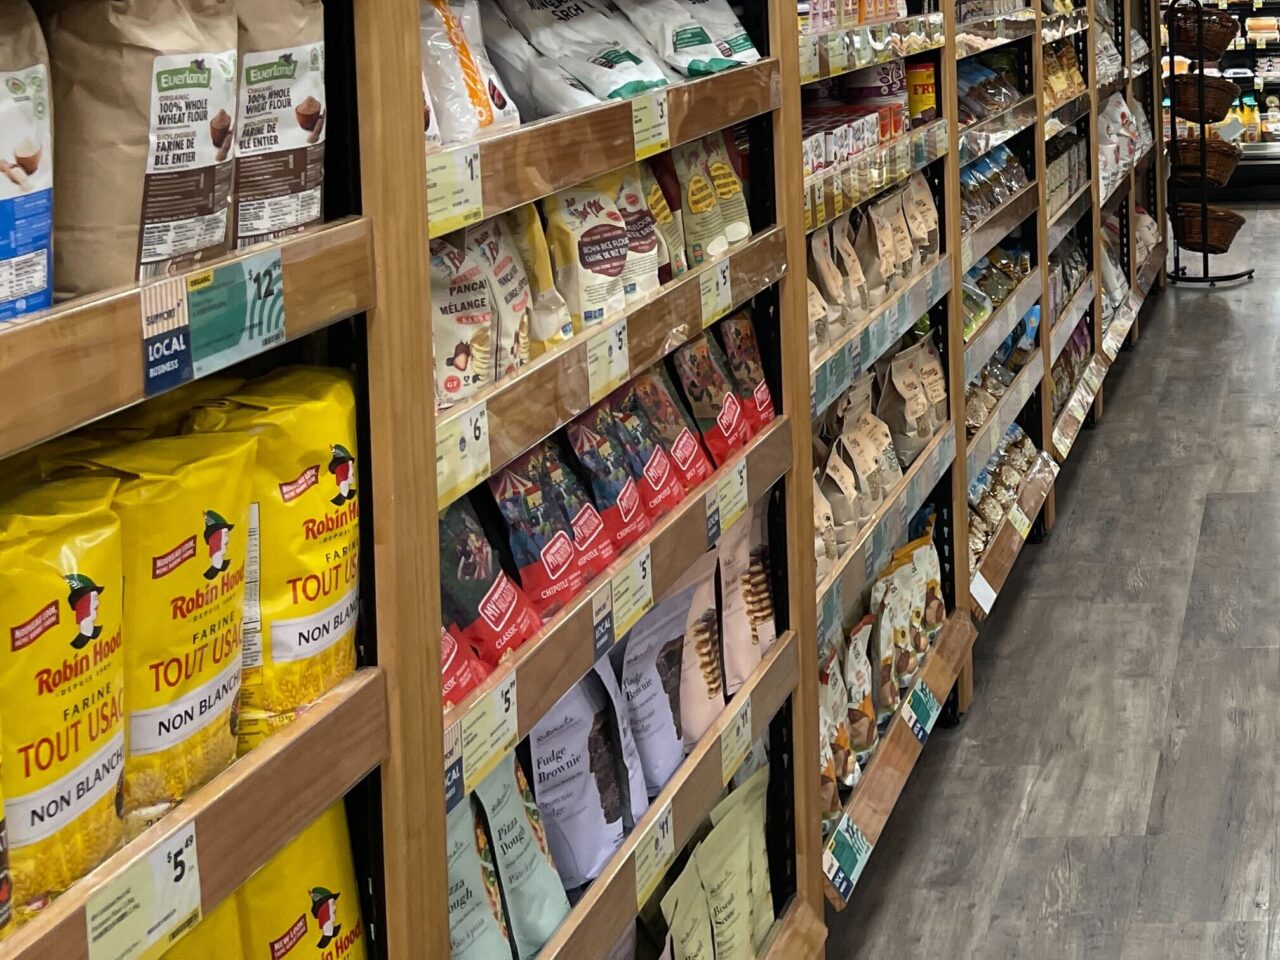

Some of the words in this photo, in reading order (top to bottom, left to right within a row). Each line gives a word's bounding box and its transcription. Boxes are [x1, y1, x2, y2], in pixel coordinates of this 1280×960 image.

[160, 71, 208, 88] Everland
[250, 64, 294, 81] Everland
[159, 101, 182, 114] 100%
[184, 99, 208, 111] WHOLE
[246, 102, 268, 115] WHEAT
[269, 98, 292, 110] FLOUR
[247, 93, 266, 105] 100%
[267, 88, 290, 101] WHOLE
[158, 111, 185, 126] WHEAT
[187, 110, 208, 123] FLOUR
[241, 126, 265, 138] FARINE
[266, 122, 276, 134] DE
[156, 138, 184, 152] FARINE
[186, 138, 195, 149] DE
[253, 135, 279, 148] ENTIER
[171, 151, 196, 164] ENTIER
[145, 308, 177, 326] SUPPORT
[148, 334, 186, 362] LOCAL
[149, 359, 179, 378] BUSINESS
[303, 510, 350, 541] Robin
[286, 562, 343, 605] TOUT
[540, 579, 569, 599] CHIPOTLE
[171, 584, 218, 620] Robin
[192, 610, 235, 645] FARINE
[298, 621, 331, 646] NON
[495, 625, 519, 650] CLASSIC
[594, 618, 612, 640] LOCAL
[34, 652, 90, 696] Robin
[92, 625, 122, 664] Hood
[149, 642, 208, 692] TOUT
[63, 681, 112, 722] FARINE
[158, 705, 194, 737] NON
[199, 670, 241, 717] BLANCH
[17, 719, 81, 778] TOUT
[536, 744, 567, 770] Fudge
[537, 753, 583, 784] Brownie
[30, 791, 71, 827] NON
[76, 744, 123, 802] BLANCH
[497, 815, 519, 841] Pizza
[499, 827, 526, 856] Dough
[449, 887, 473, 915] ough
[335, 921, 361, 957] Hood
